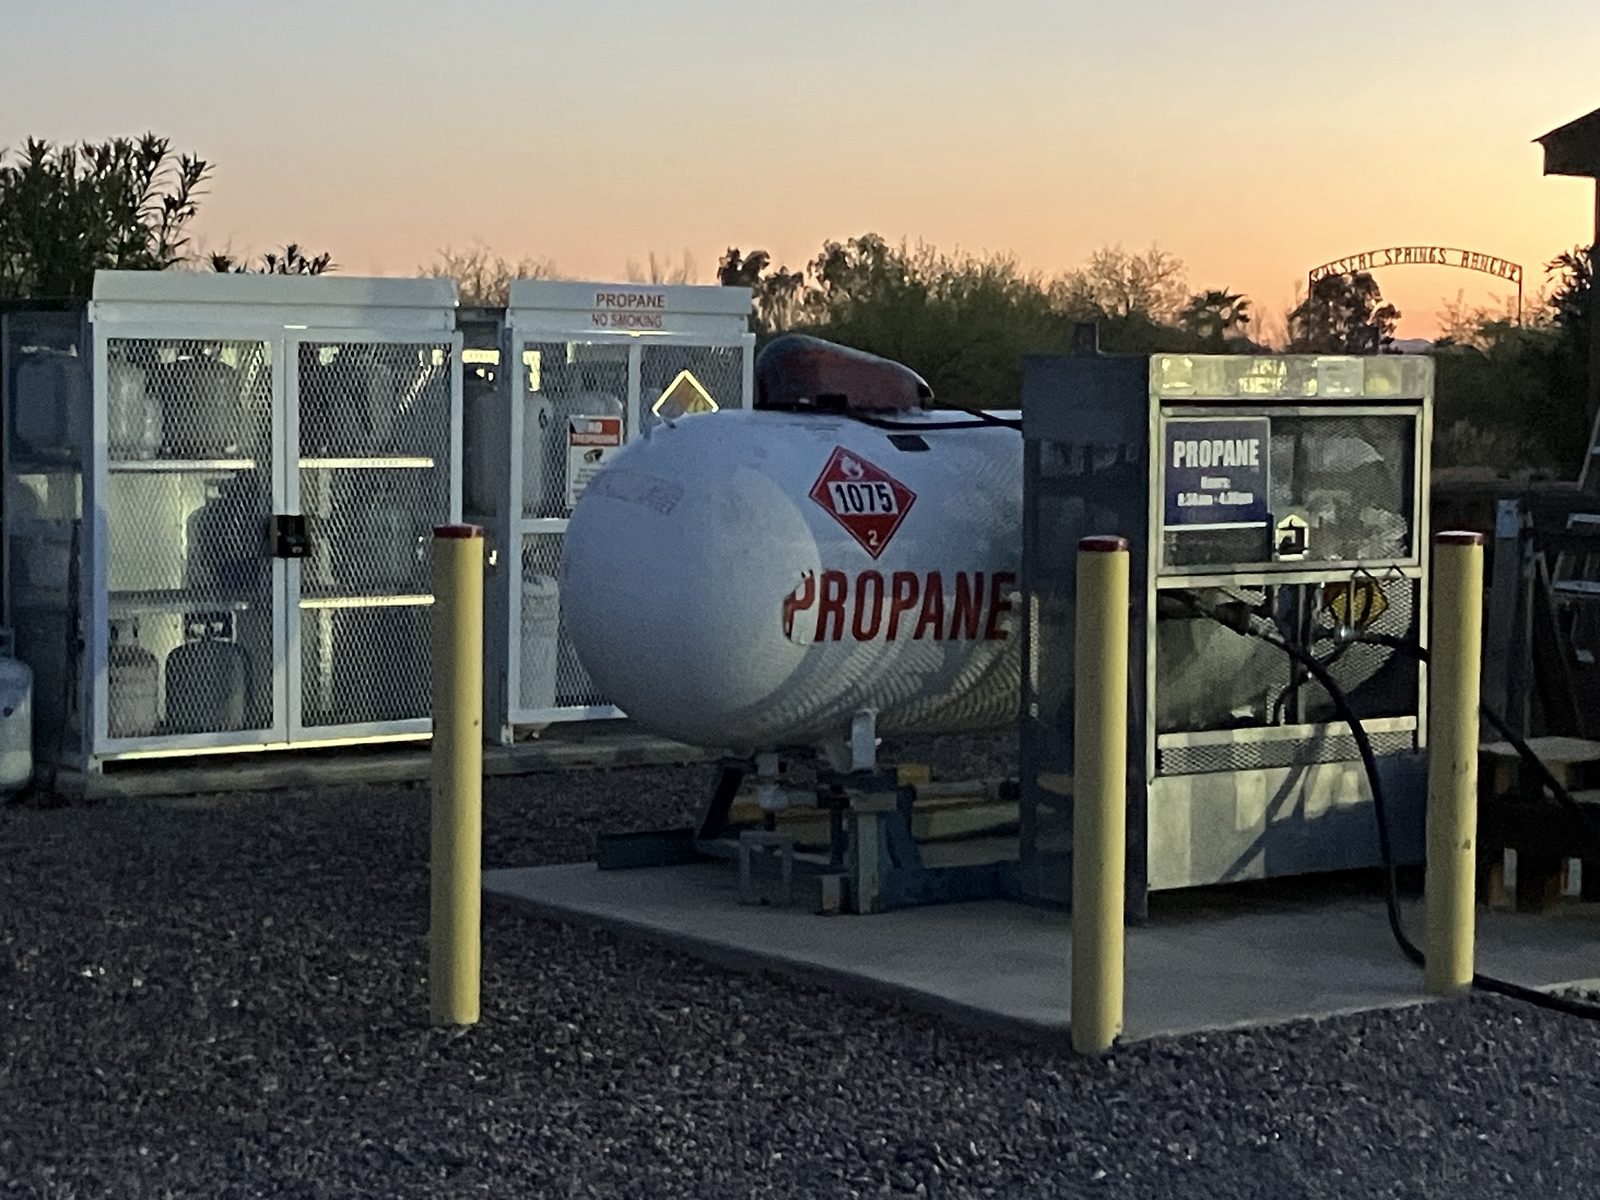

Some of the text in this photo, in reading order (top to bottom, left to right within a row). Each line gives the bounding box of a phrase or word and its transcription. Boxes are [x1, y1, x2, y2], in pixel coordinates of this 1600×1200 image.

[1385, 247, 1446, 264] SPRINGS
[596, 293, 665, 308] PROPANE
[592, 313, 663, 328] NO SMOKING
[1173, 439, 1260, 468] PROPANE
[835, 484, 893, 513] 1075
[868, 530, 879, 546] 2
[783, 569, 1016, 642] PROPANE
